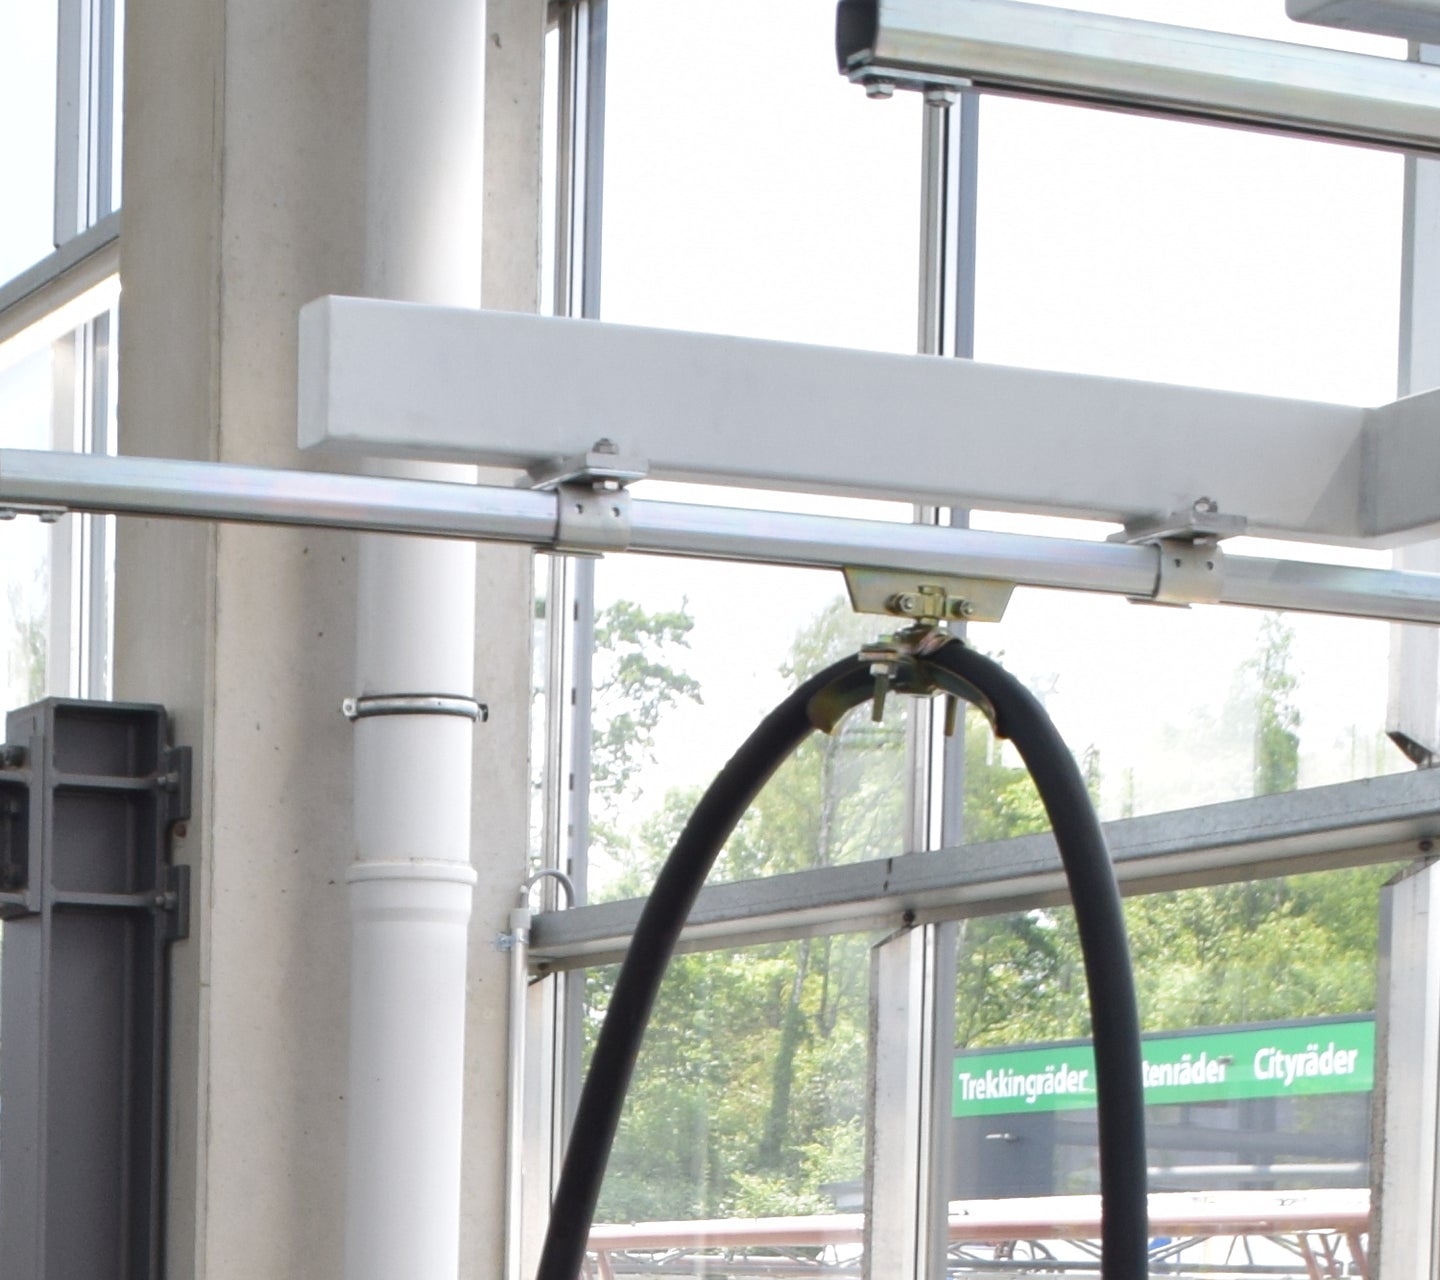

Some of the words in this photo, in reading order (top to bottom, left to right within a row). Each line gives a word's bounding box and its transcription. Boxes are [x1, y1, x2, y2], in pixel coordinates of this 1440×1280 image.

[958, 1062, 1088, 1104] Trekkingräder
[1142, 1052, 1228, 1087] tenräder
[1253, 1042, 1358, 1086] Cityräder
